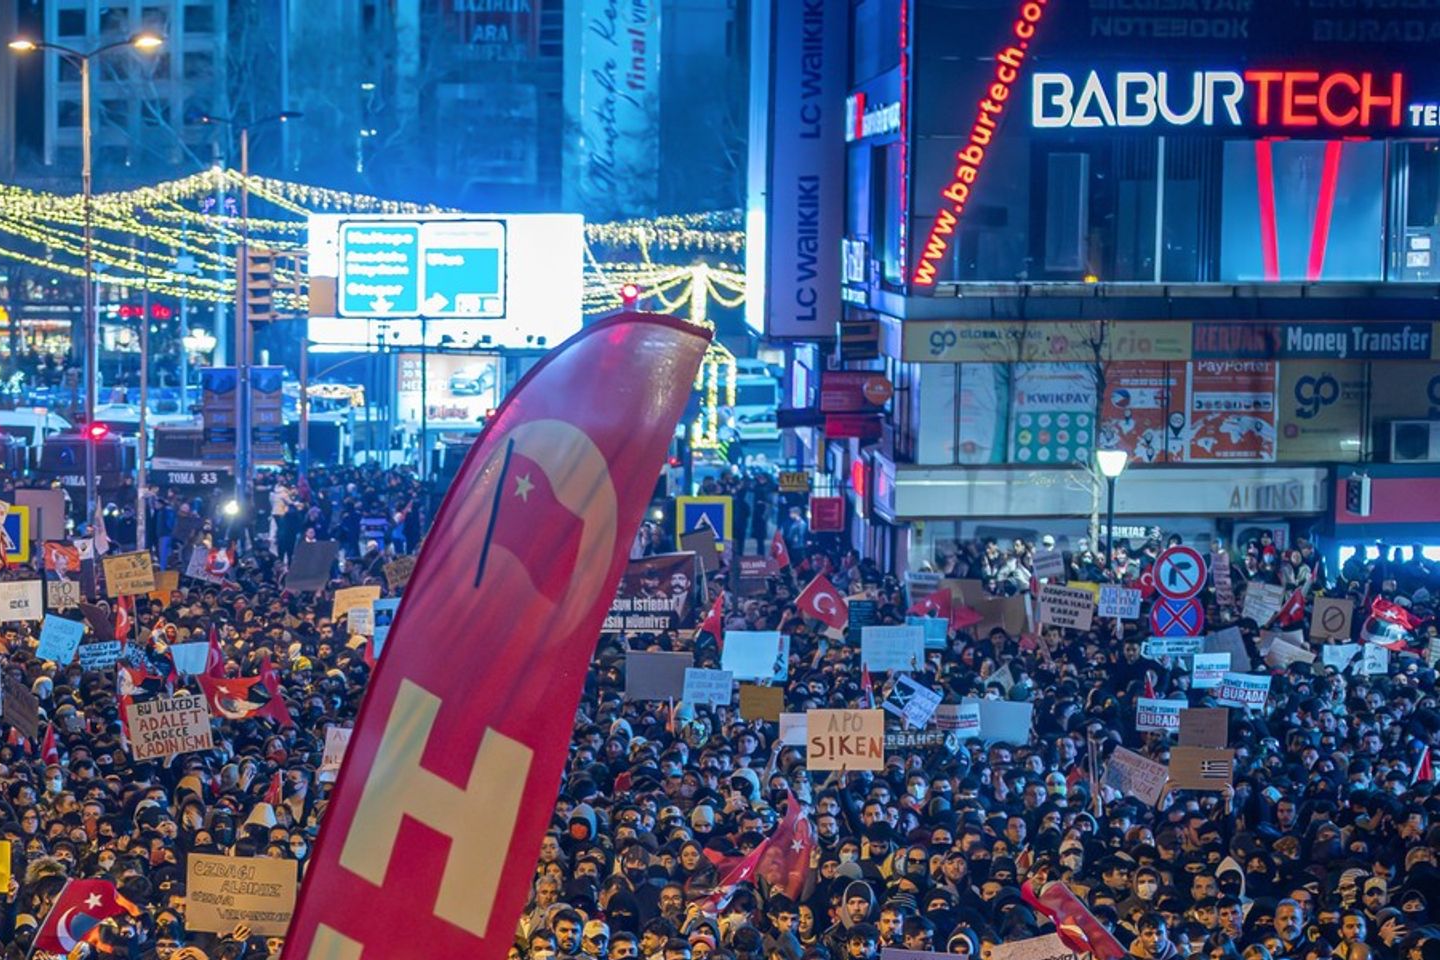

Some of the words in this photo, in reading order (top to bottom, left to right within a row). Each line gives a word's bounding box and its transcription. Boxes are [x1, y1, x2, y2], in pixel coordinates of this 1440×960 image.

[913, 0, 1047, 286] www.baburtech.co
[1287, 326, 1348, 358] Money
[1351, 326, 1430, 354] Transfer
[1026, 392, 1092, 405] KWIKPAY
[168, 472, 196, 484] TOMA
